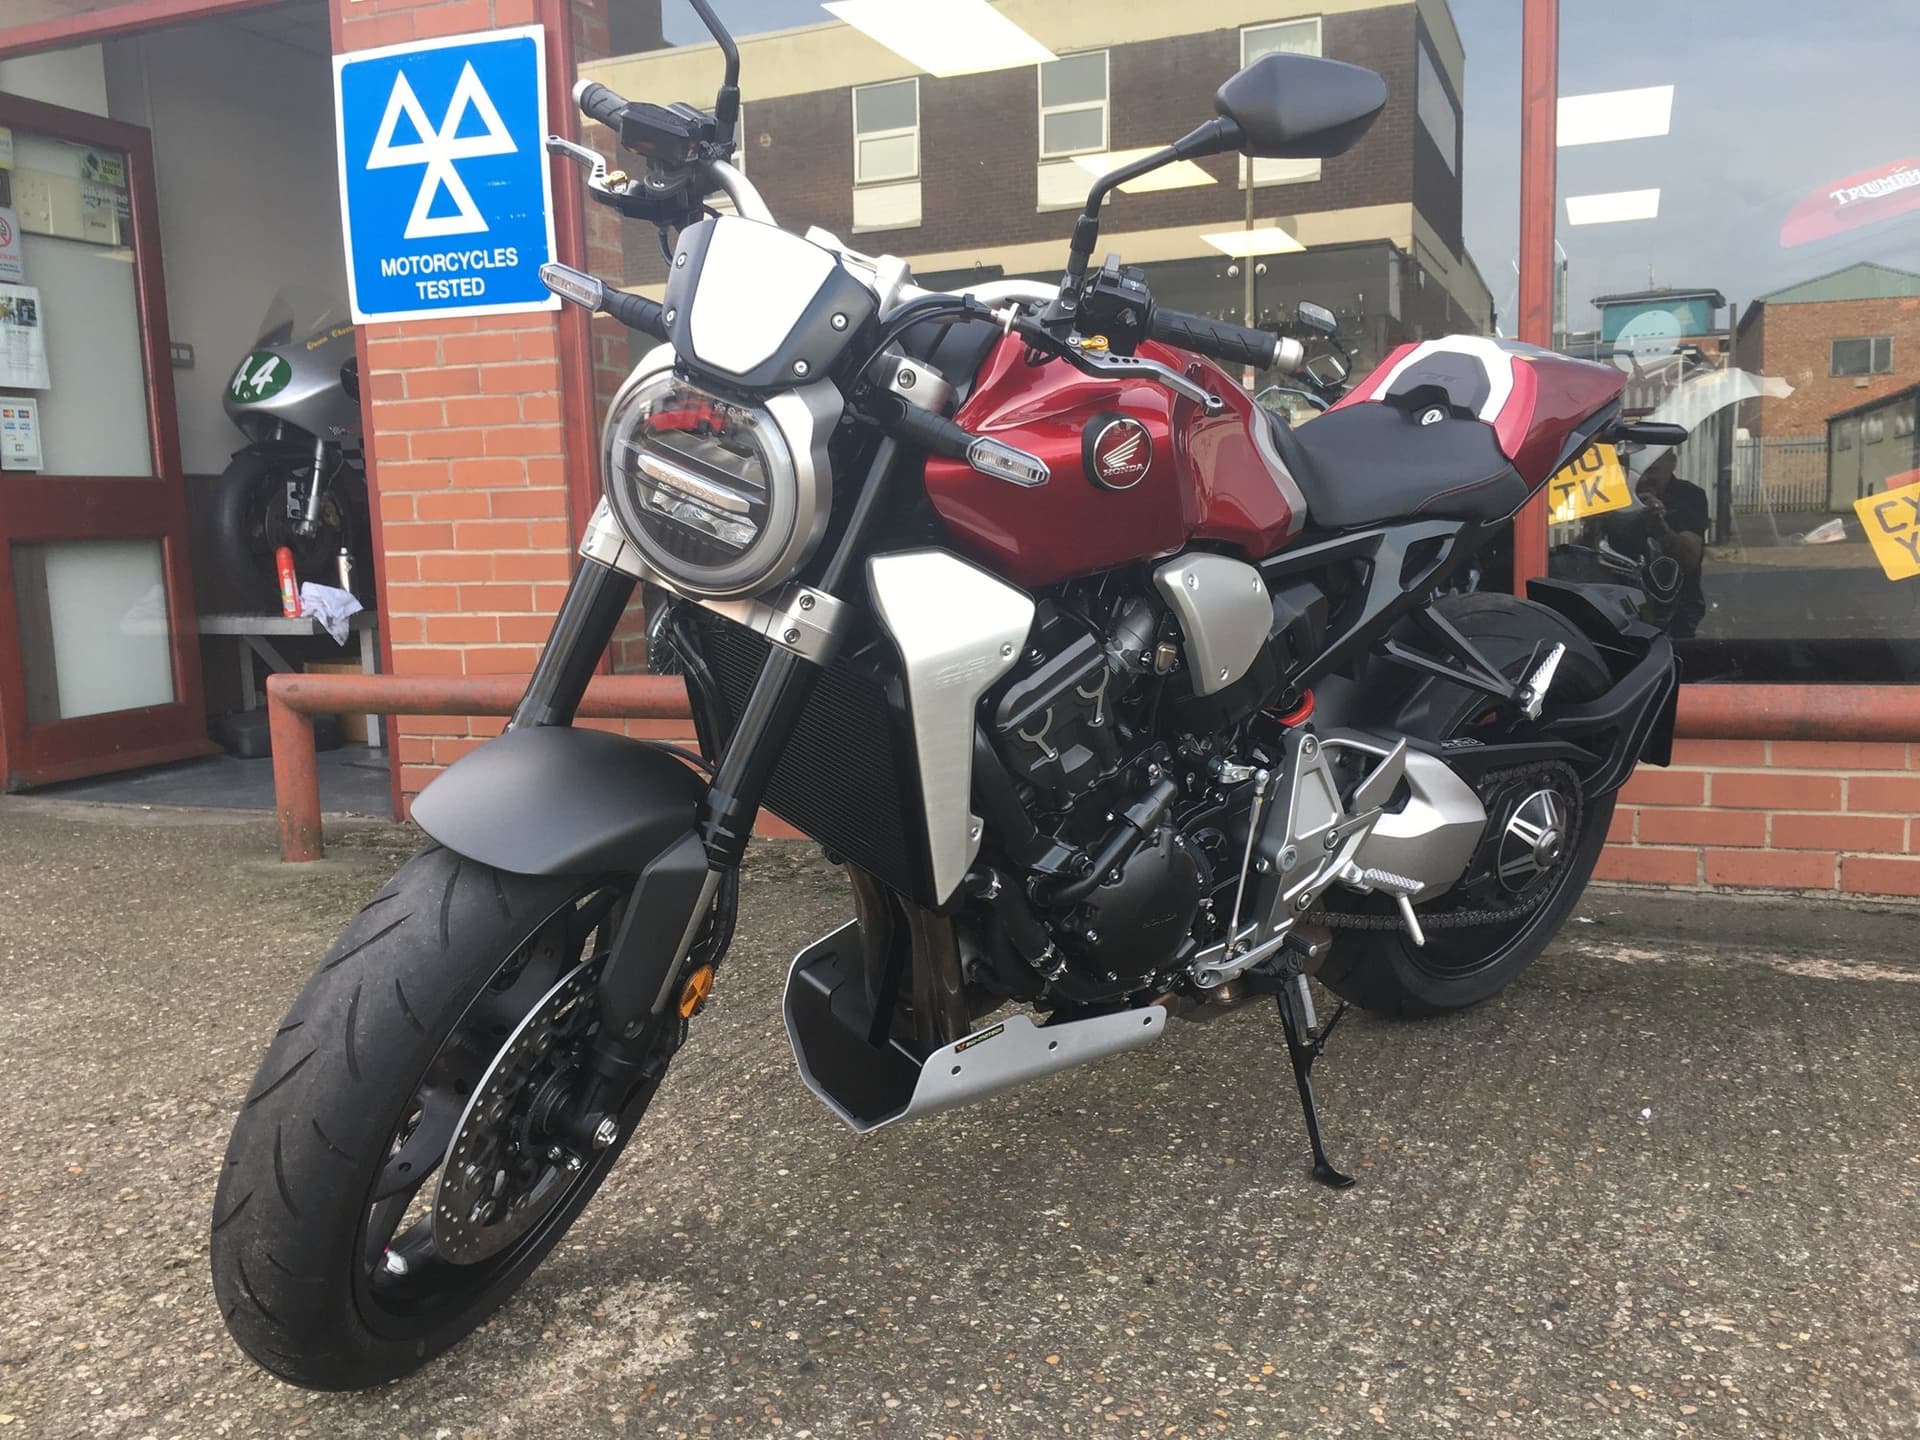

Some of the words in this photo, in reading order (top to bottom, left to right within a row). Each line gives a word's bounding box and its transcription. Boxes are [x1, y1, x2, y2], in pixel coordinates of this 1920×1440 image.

[380, 247, 519, 278] MOTORCYCLES
[415, 276, 486, 300] TESTED
[231, 354, 281, 397] 44
[1103, 464, 1144, 476] HONDA
[657, 471, 714, 501] HONDA
